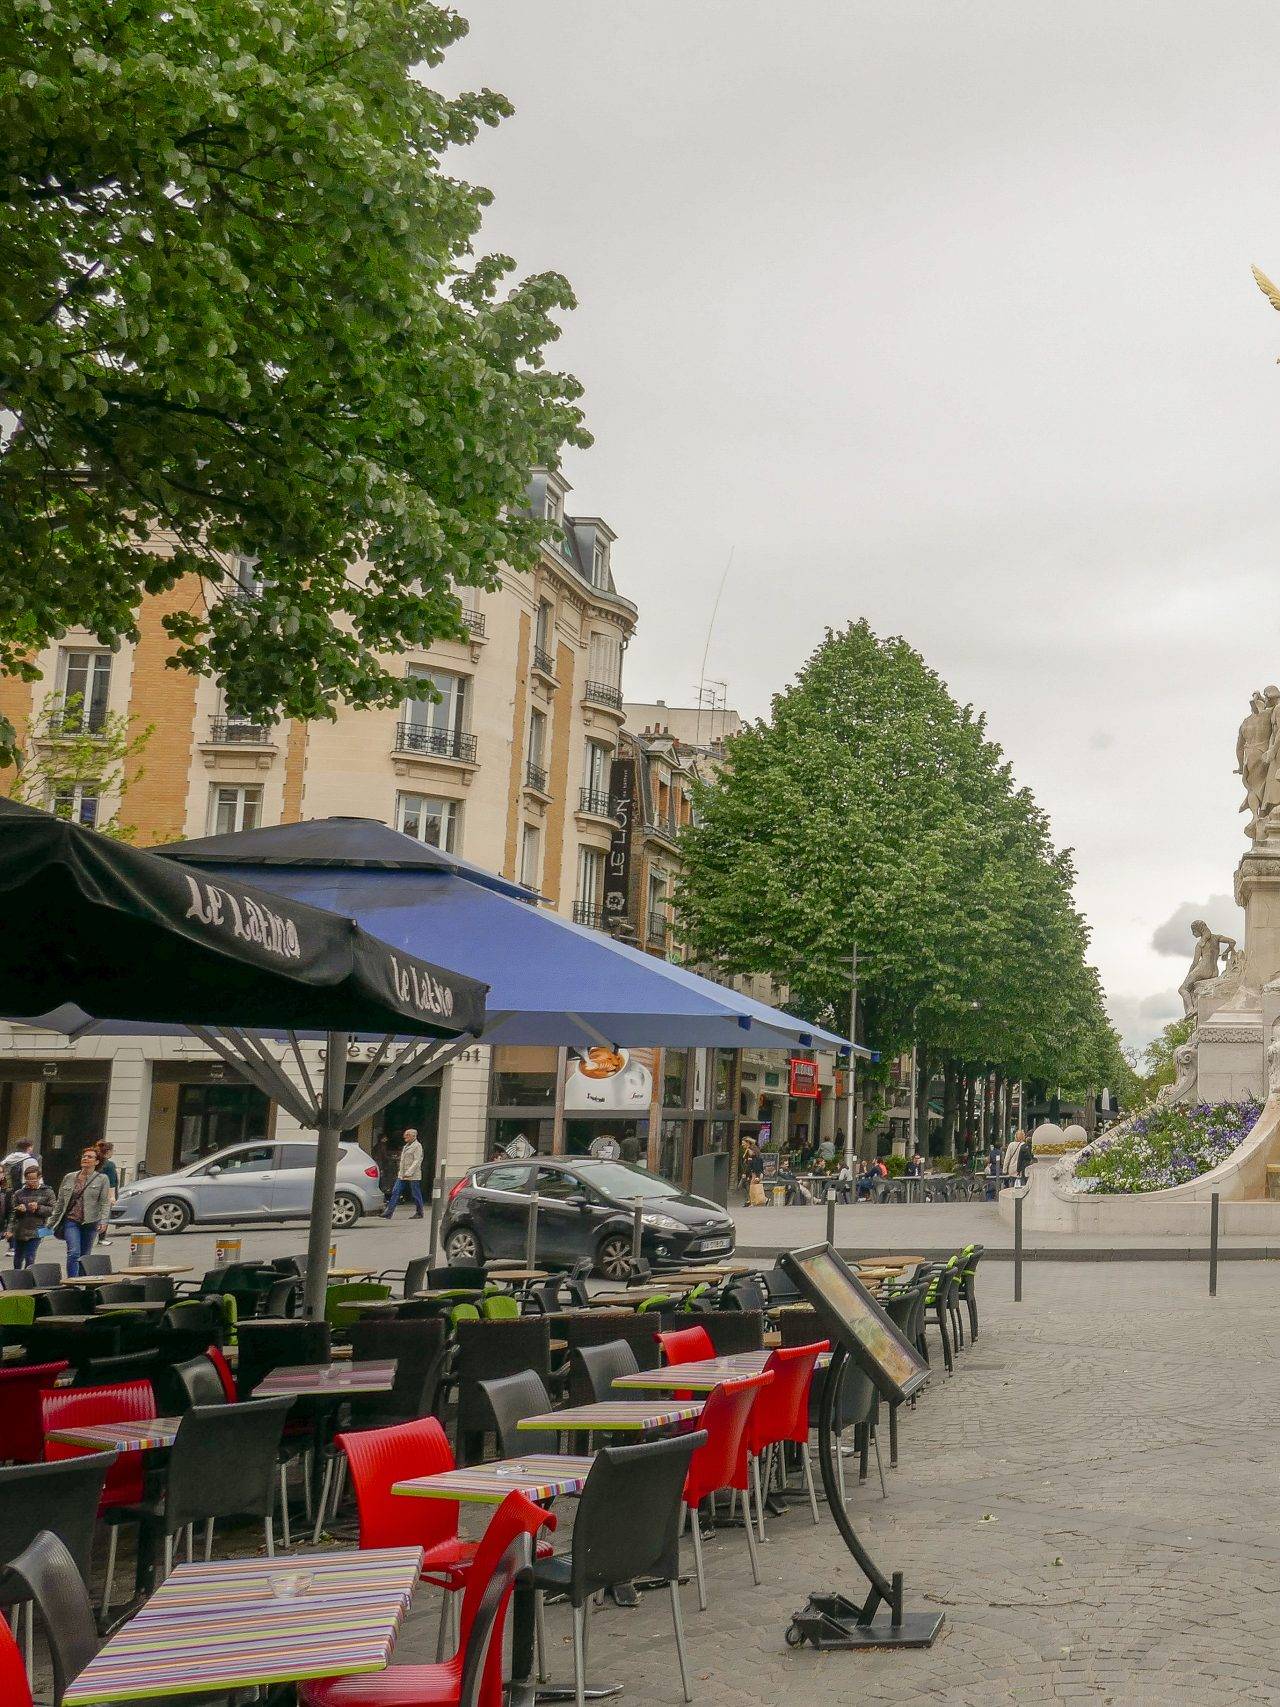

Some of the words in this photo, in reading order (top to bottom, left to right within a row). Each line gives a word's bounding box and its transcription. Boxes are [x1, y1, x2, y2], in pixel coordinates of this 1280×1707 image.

[185, 875, 224, 925] Le
[213, 886, 301, 959] Latino
[390, 953, 411, 1002] Le
[409, 965, 454, 1018] Latino
